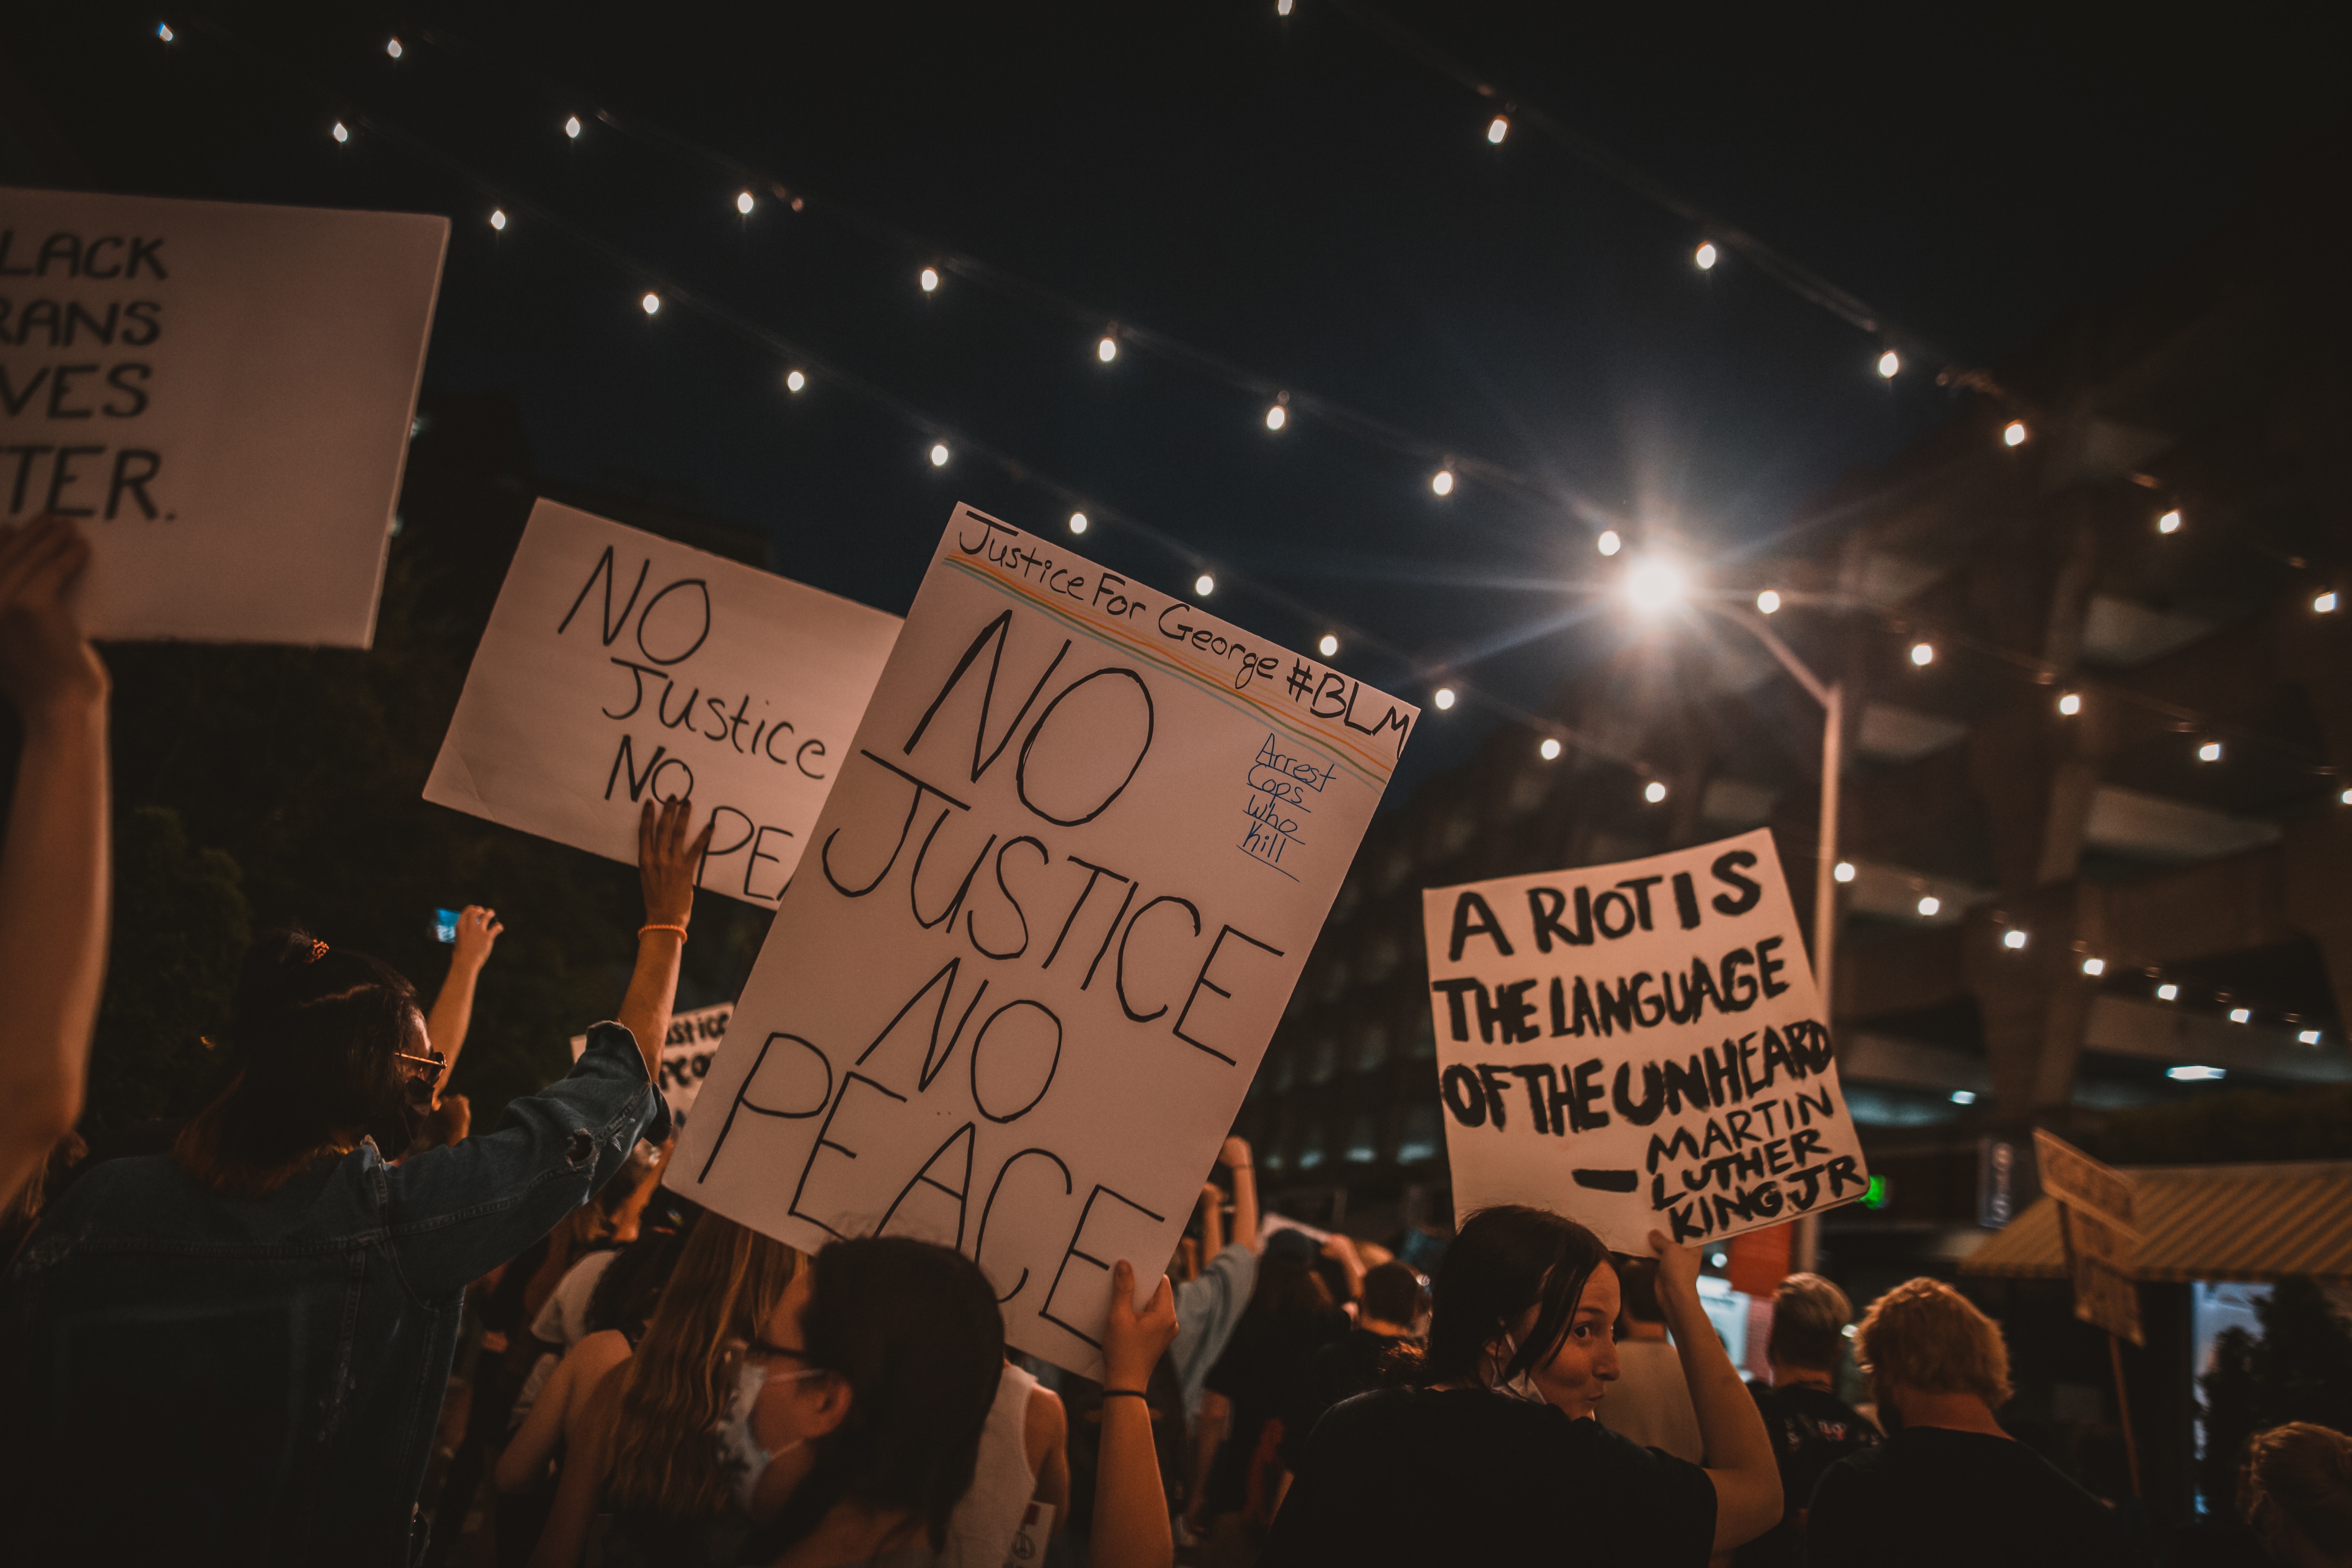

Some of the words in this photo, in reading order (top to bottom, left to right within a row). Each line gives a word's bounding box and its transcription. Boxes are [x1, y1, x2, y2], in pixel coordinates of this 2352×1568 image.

[557, 545, 710, 665] NO
[960, 510, 1084, 600] Justice
[1092, 572, 1146, 619] For
[1158, 603, 1279, 689] George
[1286, 657, 1410, 760] #BLM
[602, 657, 825, 779] Justice
[605, 735, 694, 805] NO
[903, 609, 1154, 827] NO
[1255, 733, 1336, 792] Arrest
[1248, 763, 1303, 808] Cops
[696, 806, 793, 901] PE
[822, 749, 1285, 1067] JUSTICE
[1449, 891, 1514, 962] A
[1527, 876, 1663, 953] RIOT
[1673, 851, 1761, 930] IS
[856, 957, 1062, 1123] NO
[1433, 978, 1540, 1044] THE
[1550, 936, 1791, 1037] LANGUAGE
[1441, 1064, 1513, 1131] OF
[1512, 1059, 1610, 1136] THE
[1613, 1020, 1833, 1126] UNHEARD
[1646, 1085, 1833, 1174] MARTIN
[697, 1032, 1166, 1352] PEACE
[1652, 1129, 1832, 1209] LUTHER
[1668, 1180, 1783, 1243] KING
